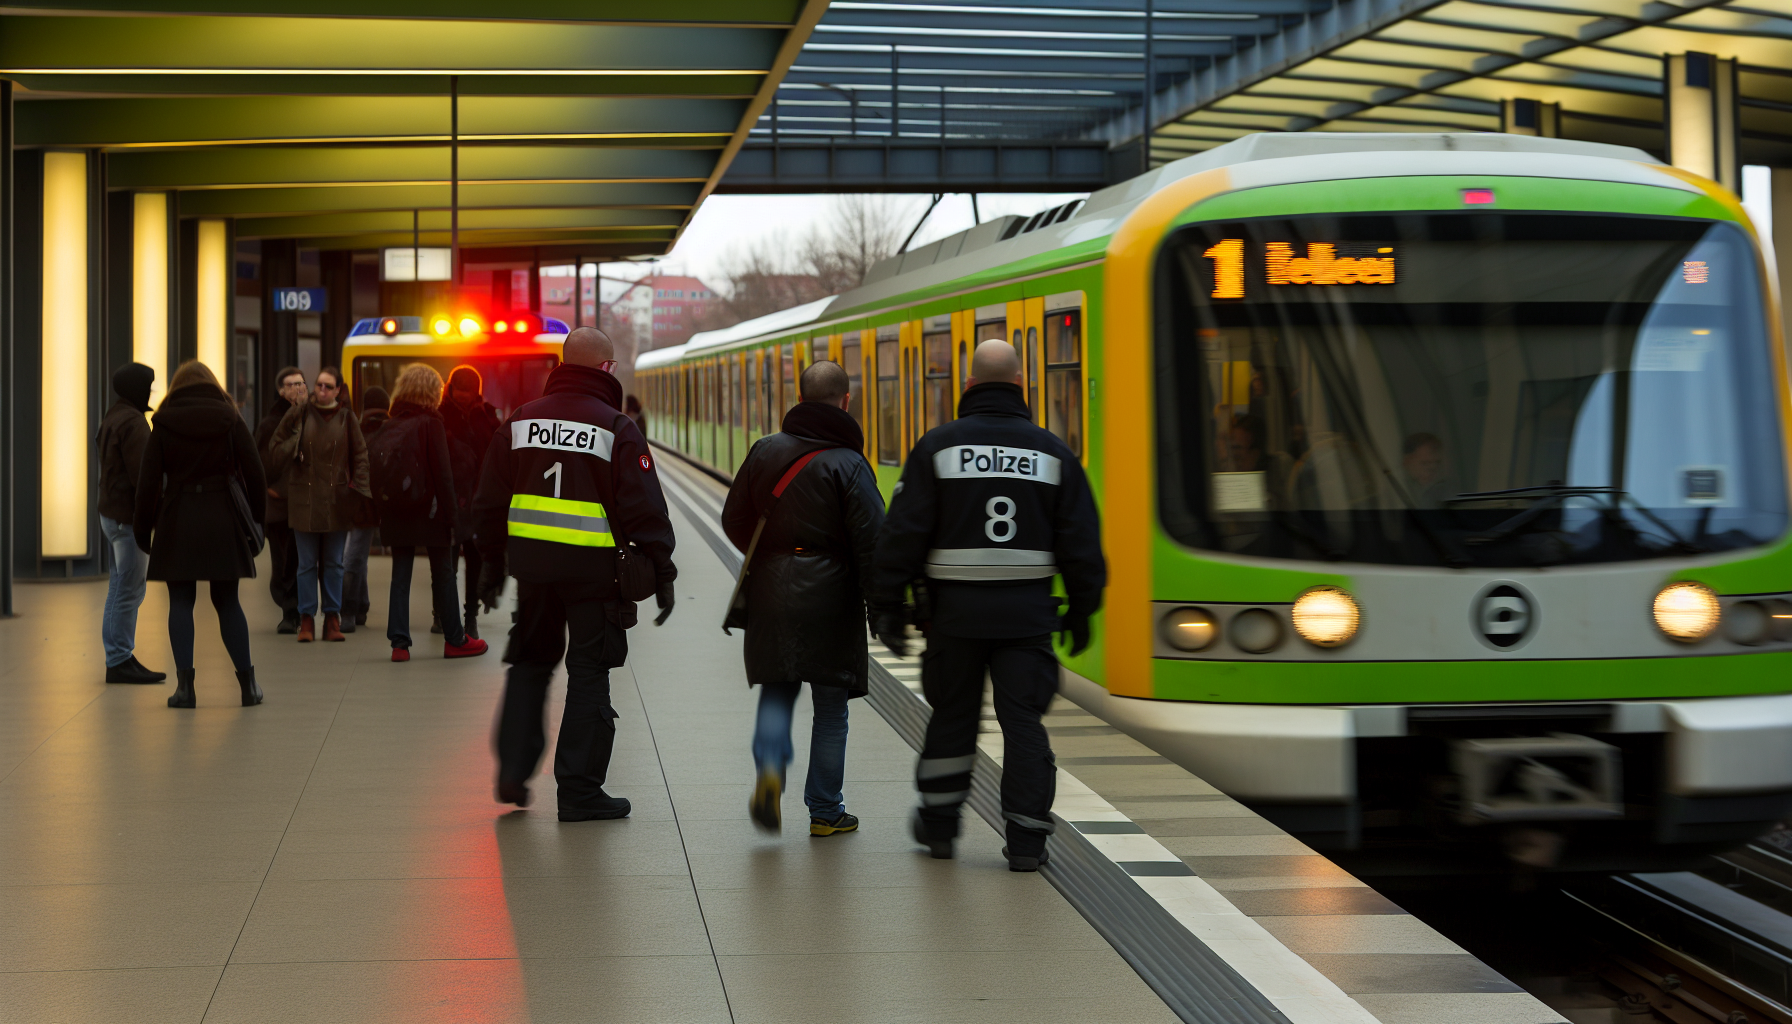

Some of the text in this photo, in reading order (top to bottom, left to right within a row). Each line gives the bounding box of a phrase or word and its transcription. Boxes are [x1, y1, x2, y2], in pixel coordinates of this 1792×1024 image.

[1202, 238, 1245, 298] 1
[543, 461, 563, 499] 1
[960, 447, 1038, 476] Polizei
[984, 495, 1018, 543] 8
